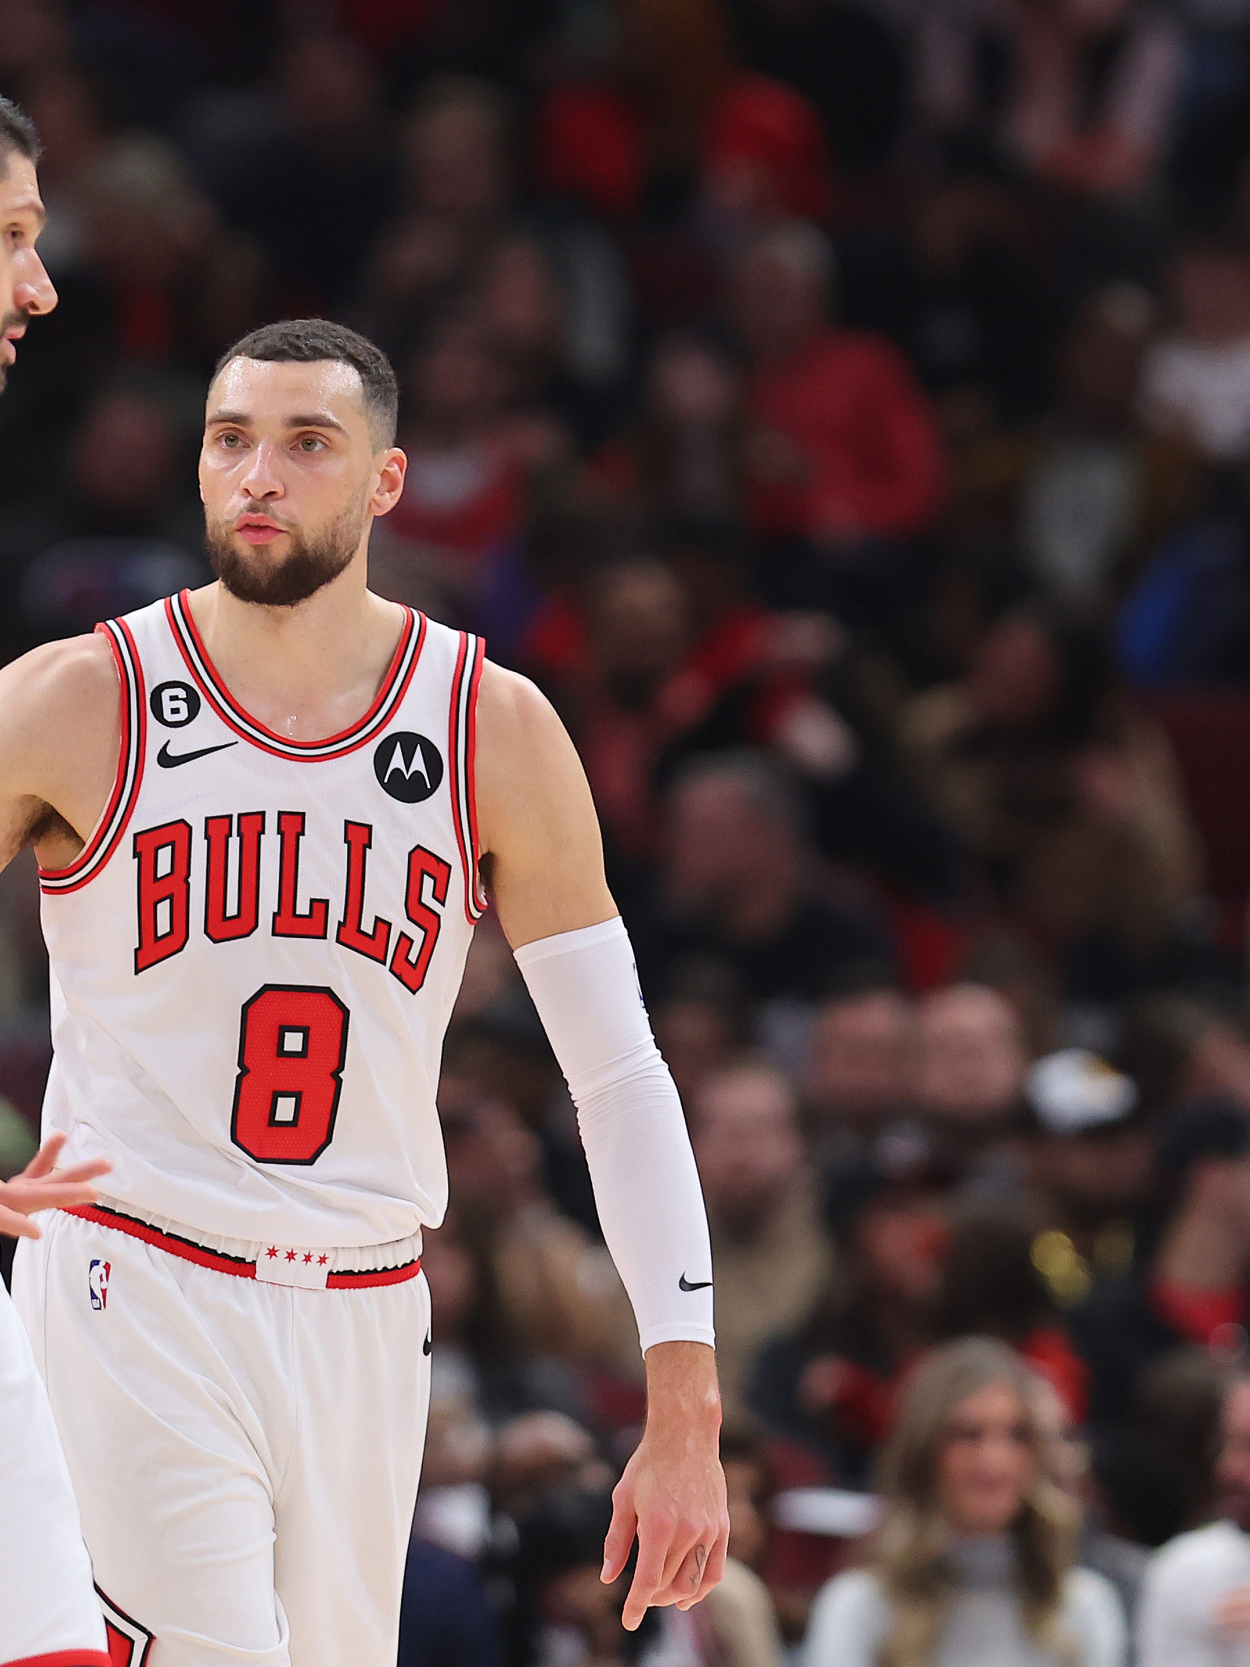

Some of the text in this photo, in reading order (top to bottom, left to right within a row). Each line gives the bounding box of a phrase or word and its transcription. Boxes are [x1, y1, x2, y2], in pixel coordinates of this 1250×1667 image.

[160, 687, 189, 722] 6
[132, 811, 451, 995] BULLS
[230, 984, 350, 1166] 8
